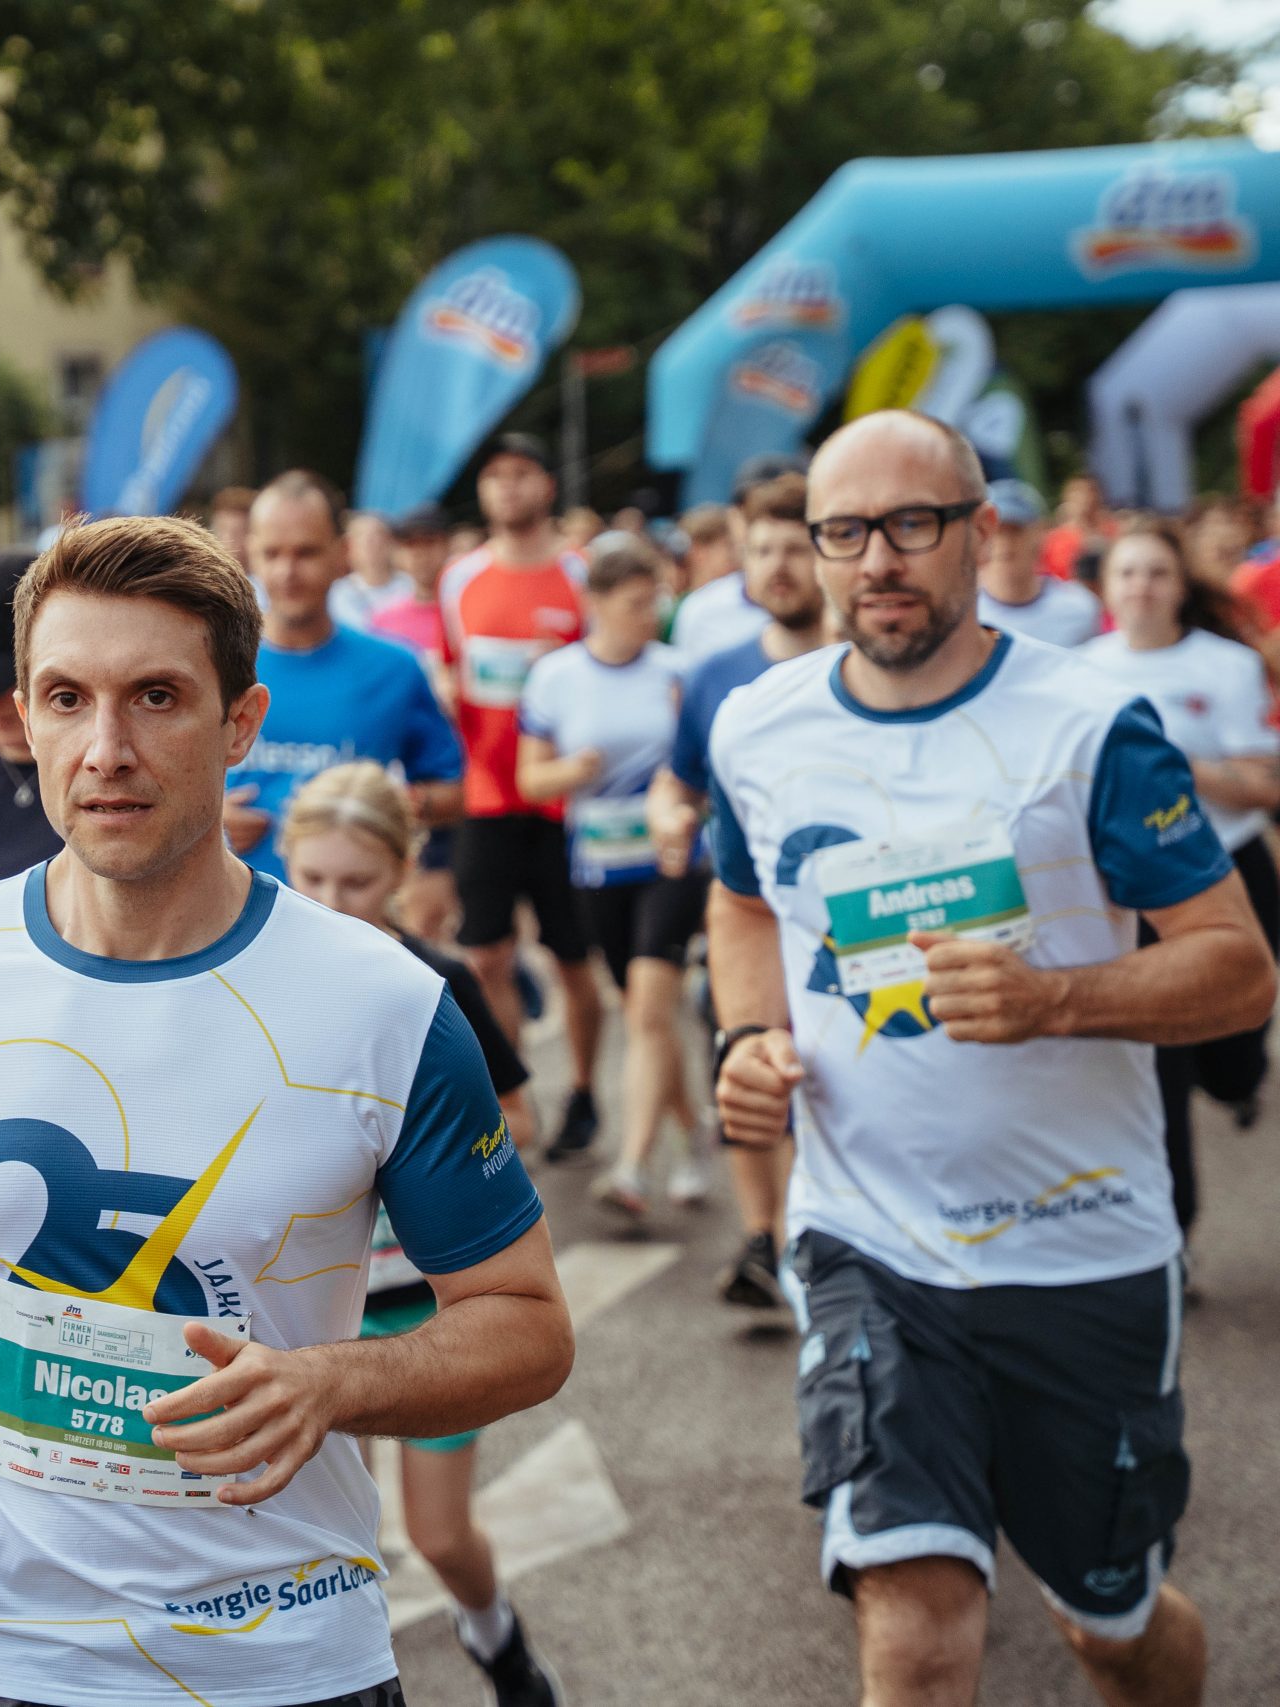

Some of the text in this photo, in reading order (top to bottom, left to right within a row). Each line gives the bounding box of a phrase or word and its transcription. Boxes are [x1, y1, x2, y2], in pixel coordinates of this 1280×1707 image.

[869, 875, 976, 919] Andreas
[66, 1304, 82, 1315] dm
[63, 1321, 92, 1334] FIRMEN
[62, 1332, 91, 1346] LAUF
[70, 1408, 125, 1436] 5778
[64, 1433, 96, 1447] STARTZEIT
[113, 1444, 127, 1452] UHR
